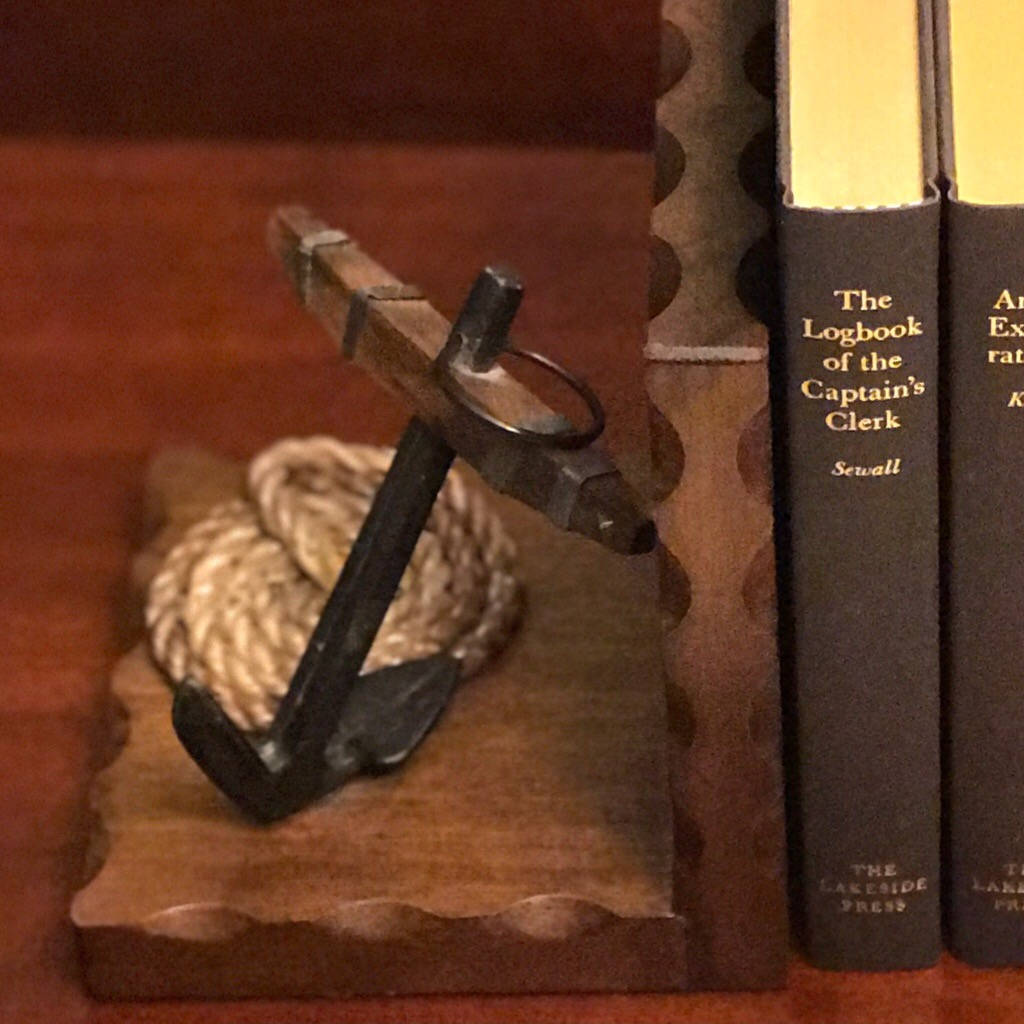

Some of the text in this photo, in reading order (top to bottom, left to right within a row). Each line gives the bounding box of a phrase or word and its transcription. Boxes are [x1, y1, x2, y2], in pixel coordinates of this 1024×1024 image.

[833, 289, 893, 312] The
[802, 316, 924, 348] Logbook
[822, 352, 903, 372] of the
[801, 376, 926, 408] Captain's
[825, 410, 901, 432] Clerk
[831, 458, 901, 477] Sewall
